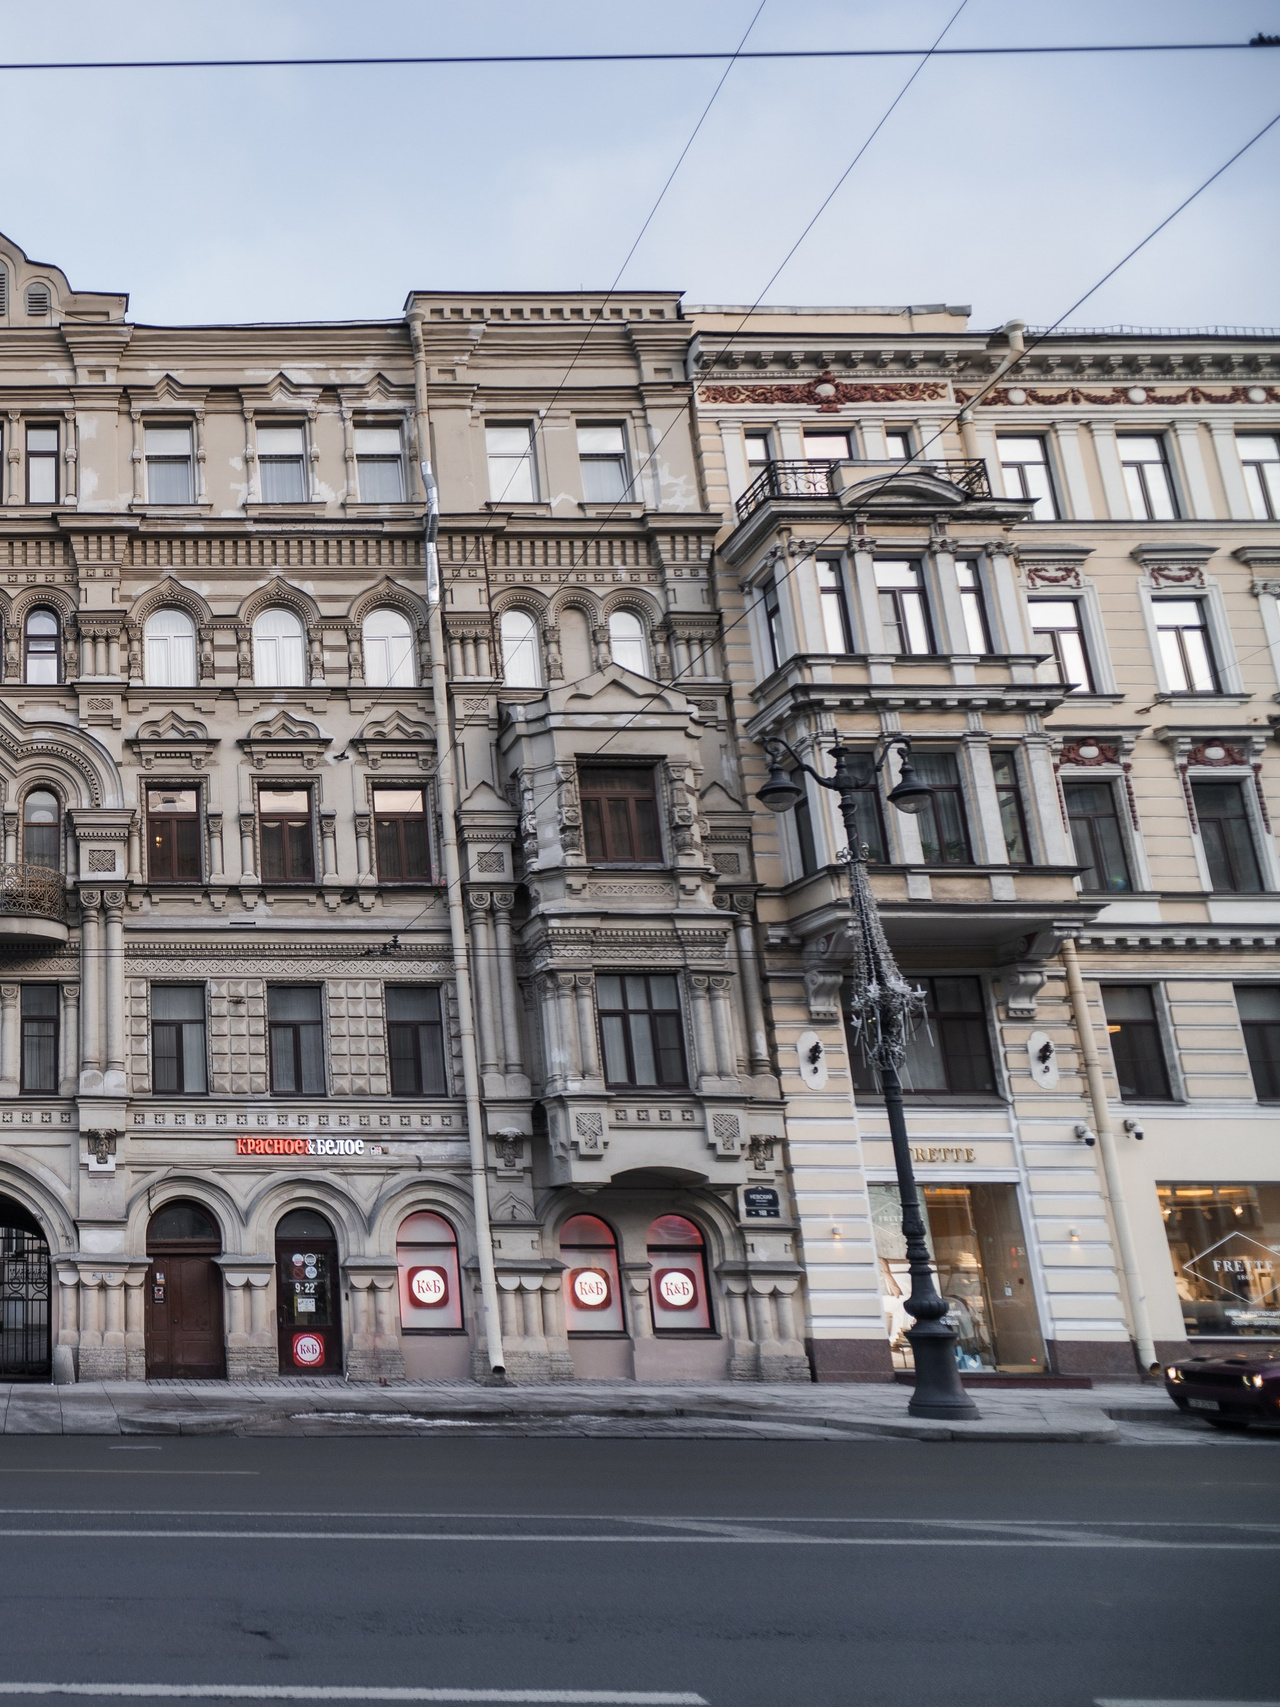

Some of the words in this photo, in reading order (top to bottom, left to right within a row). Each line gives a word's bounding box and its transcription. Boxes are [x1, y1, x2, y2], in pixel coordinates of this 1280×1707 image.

[908, 1147, 976, 1162] RETTE
[1213, 1260, 1275, 1272] FRETTE
[416, 1279, 441, 1294] К&Б
[579, 1281, 604, 1296] К&Б
[664, 1281, 690, 1296] К&Б
[300, 1344, 318, 1355] К&Б
